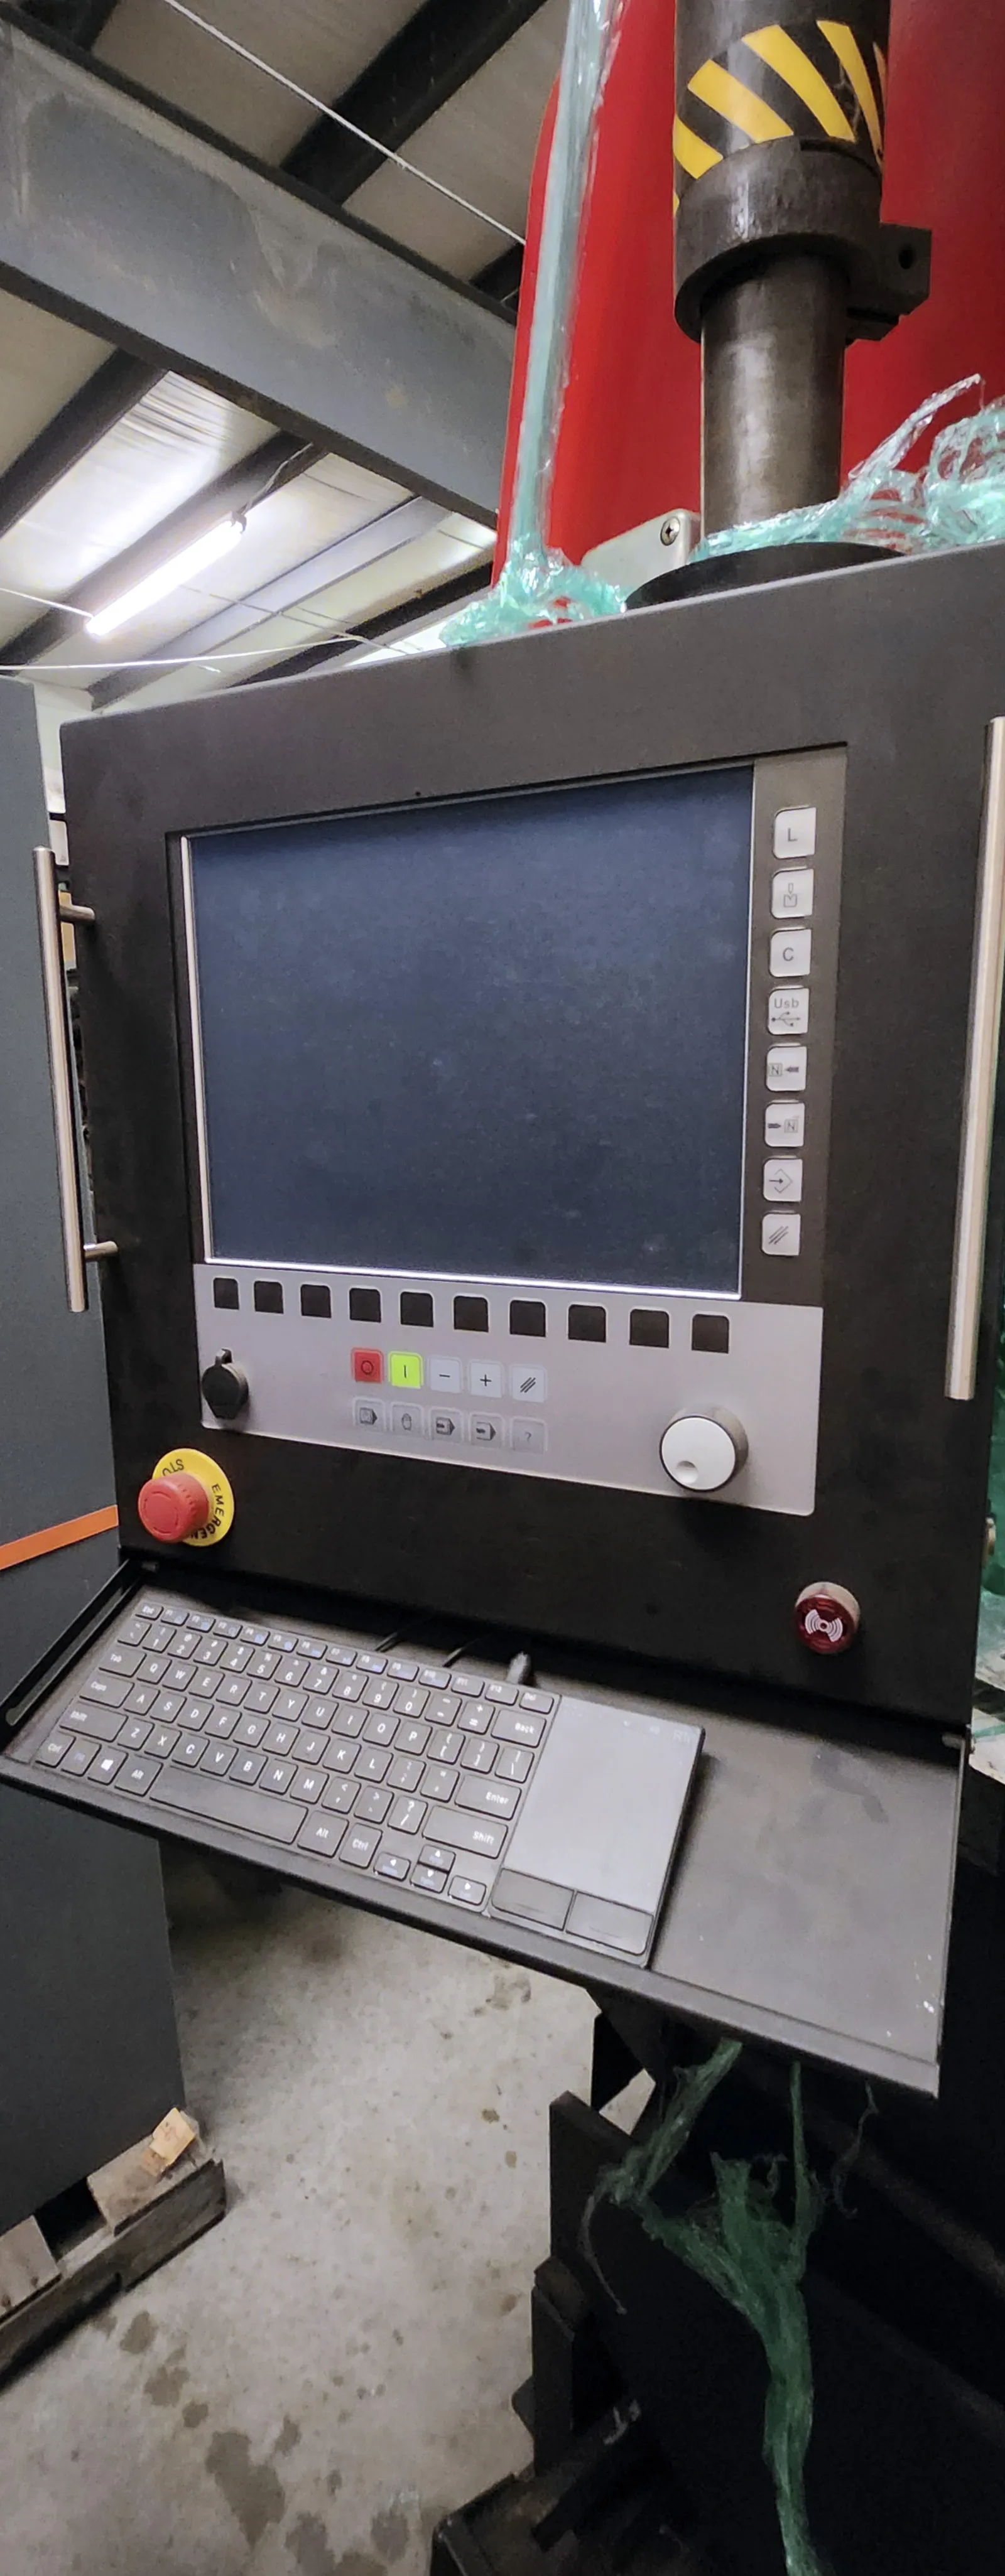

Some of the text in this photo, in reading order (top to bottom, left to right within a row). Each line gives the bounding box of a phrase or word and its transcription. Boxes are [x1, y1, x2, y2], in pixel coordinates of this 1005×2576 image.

[787, 827, 798, 842] L
[782, 947, 795, 962] C
[774, 998, 800, 1009] Usb
[161, 1458, 185, 1477] STO
[176, 1646, 185, 1654] 2
[203, 1651, 212, 1661] 3
[230, 1658, 238, 1667] 4
[149, 1664, 158, 1673] Q
[257, 1664, 266, 1674] 5
[175, 1669, 186, 1679] W
[285, 1672, 293, 1681] 6
[202, 1677, 211, 1687] E
[314, 1678, 322, 1688] 7
[229, 1684, 238, 1694] R
[344, 1686, 352, 1696] 8
[136, 1694, 145, 1703] A
[259, 1691, 267, 1701] T
[374, 1693, 382, 1703] 9
[163, 1701, 173, 1711] S
[288, 1699, 296, 1709] Y
[190, 1708, 199, 1718] D
[315, 1706, 325, 1717] U
[219, 1716, 227, 1726] F
[131, 1727, 140, 1738] Z
[247, 1725, 256, 1735] G
[377, 1722, 386, 1733] O
[514, 1722, 535, 1734] Back
[158, 1735, 168, 1746] X
[276, 1732, 286, 1743] H
[408, 1731, 418, 1741] P
[185, 1743, 195, 1755] C
[307, 1741, 315, 1751] J
[215, 1752, 224, 1763] V
[337, 1749, 346, 1760] K
[243, 1760, 253, 1772] B
[369, 1758, 376, 1769] L
[273, 1769, 284, 1781] N
[303, 1778, 315, 1790] M
[486, 1791, 509, 1804] Enter
[315, 1827, 329, 1839] Alt
[472, 1830, 494, 1846] Shift
[352, 1838, 369, 1851] Ctrl
